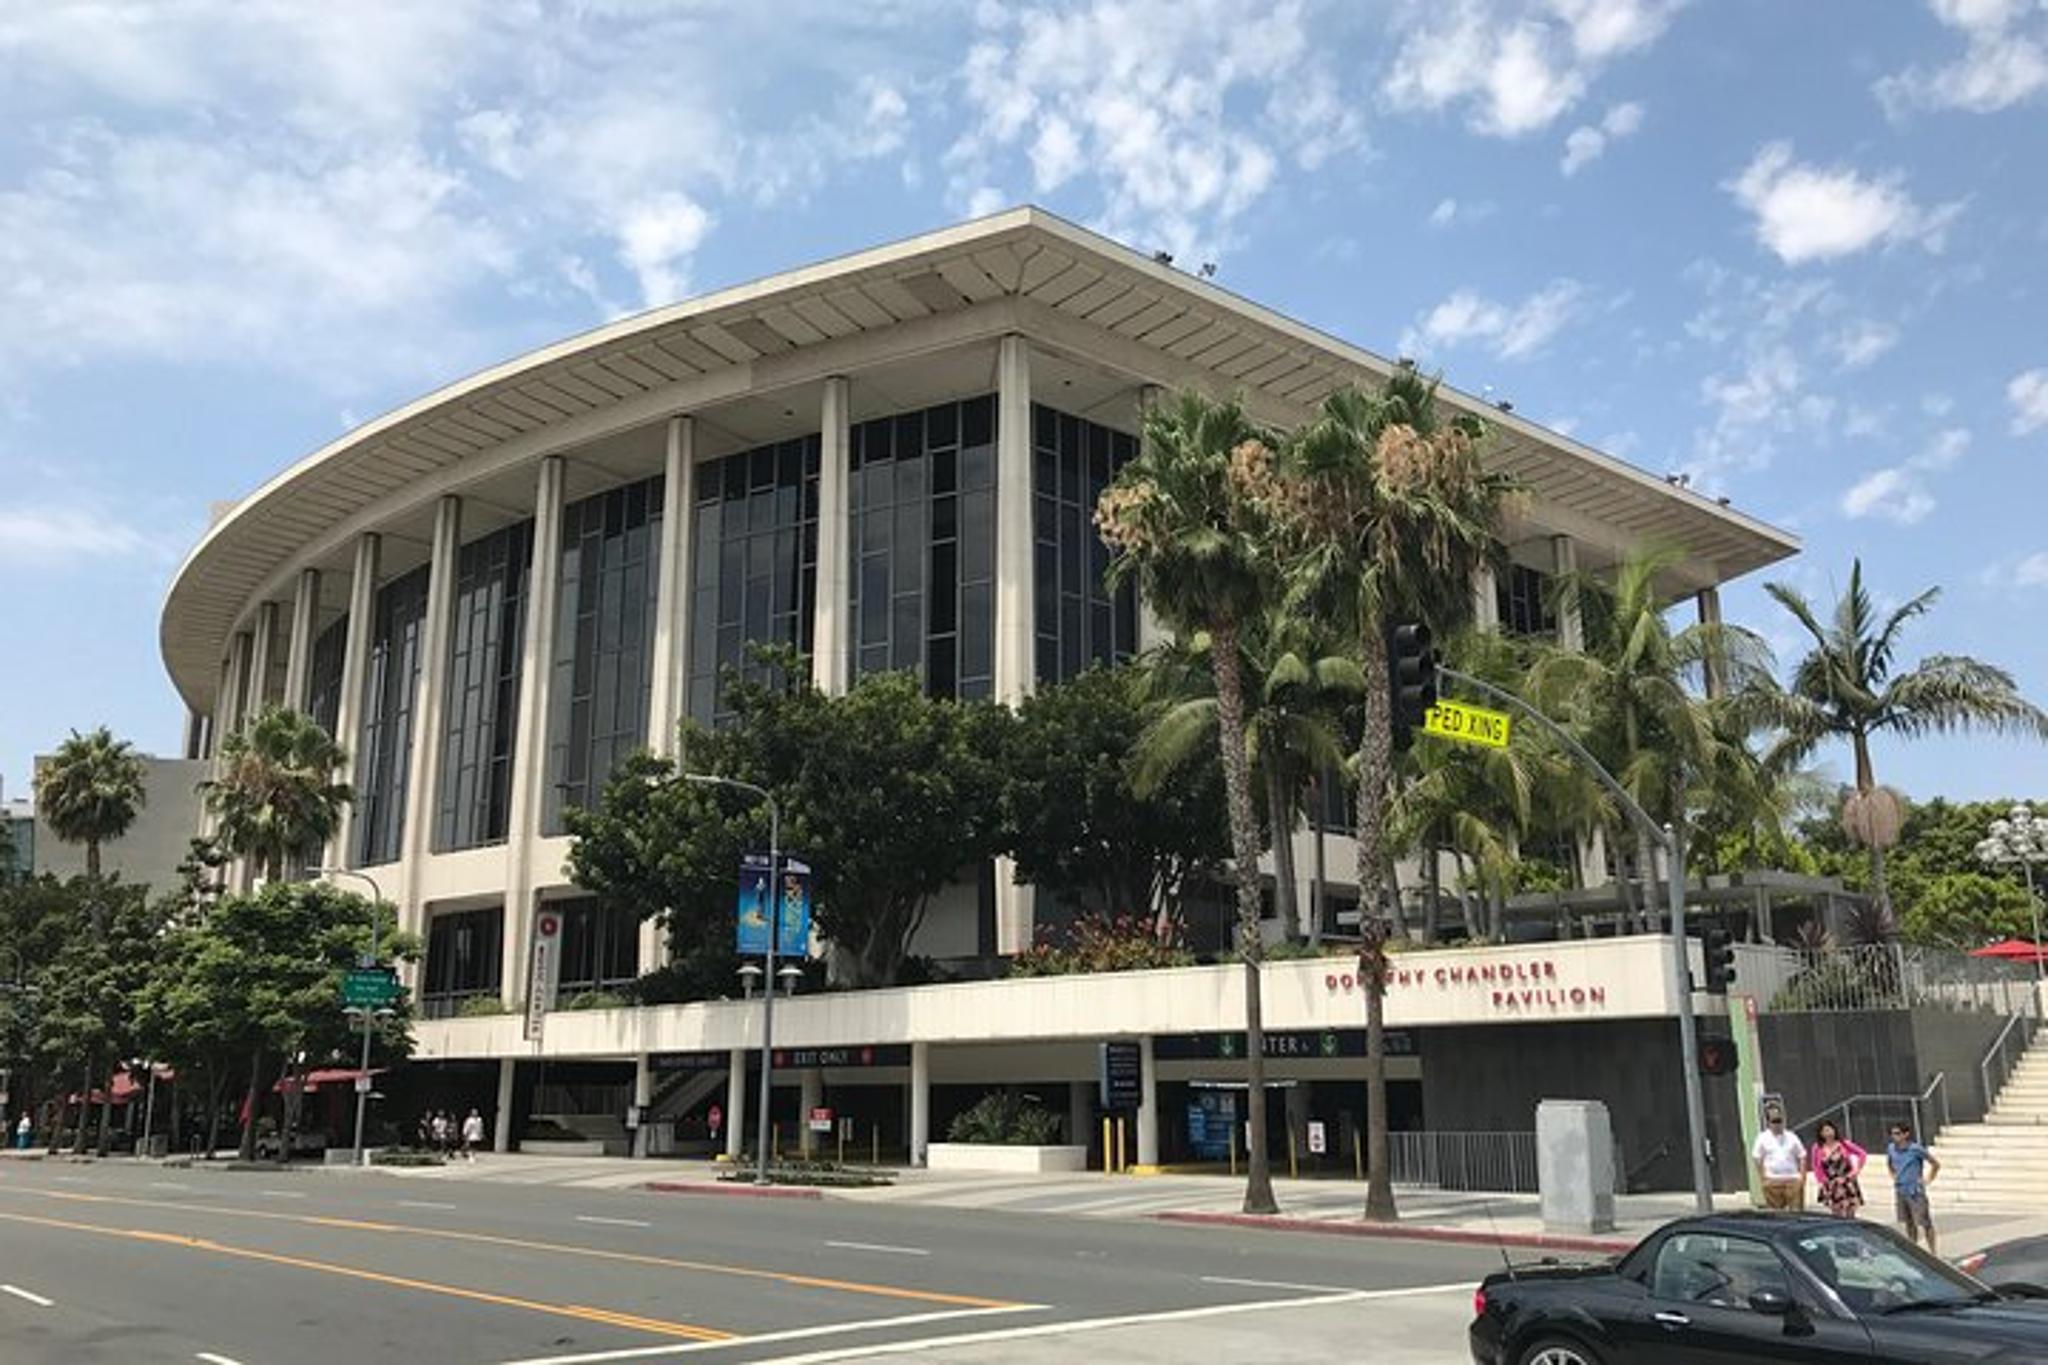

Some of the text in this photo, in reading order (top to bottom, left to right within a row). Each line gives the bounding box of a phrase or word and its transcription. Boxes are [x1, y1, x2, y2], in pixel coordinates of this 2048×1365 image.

[1430, 705, 1503, 740] PED XING
[1433, 961, 1557, 985] CHANDLER
[1492, 986, 1605, 1007] PAVILION
